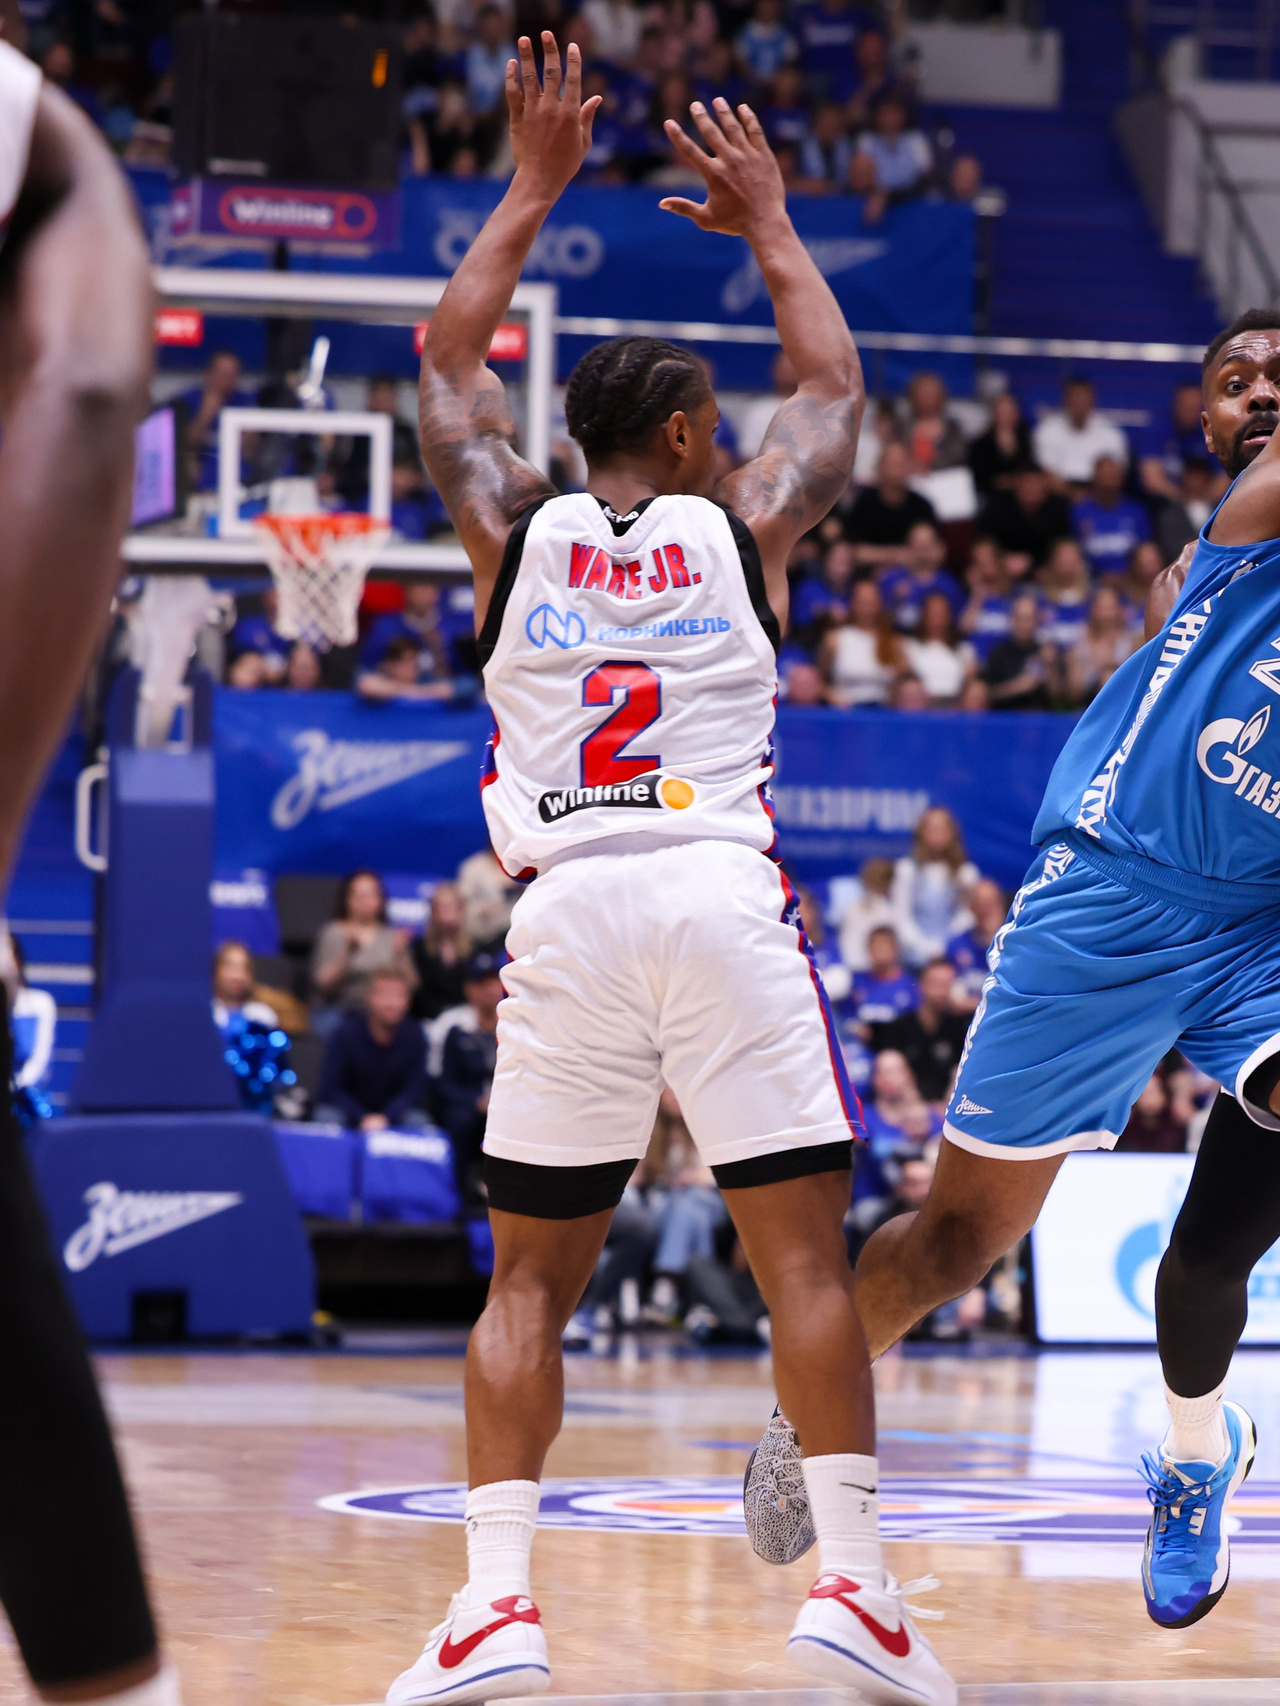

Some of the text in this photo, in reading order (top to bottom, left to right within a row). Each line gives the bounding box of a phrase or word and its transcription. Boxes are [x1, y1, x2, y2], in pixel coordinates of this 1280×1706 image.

[568, 541, 702, 600] WARE JR.
[598, 616, 731, 641] НОРНИКЕЛЬ
[580, 659, 662, 789] 2
[544, 782, 651, 817] Winline
[774, 785, 930, 832] АЗПРОМ
